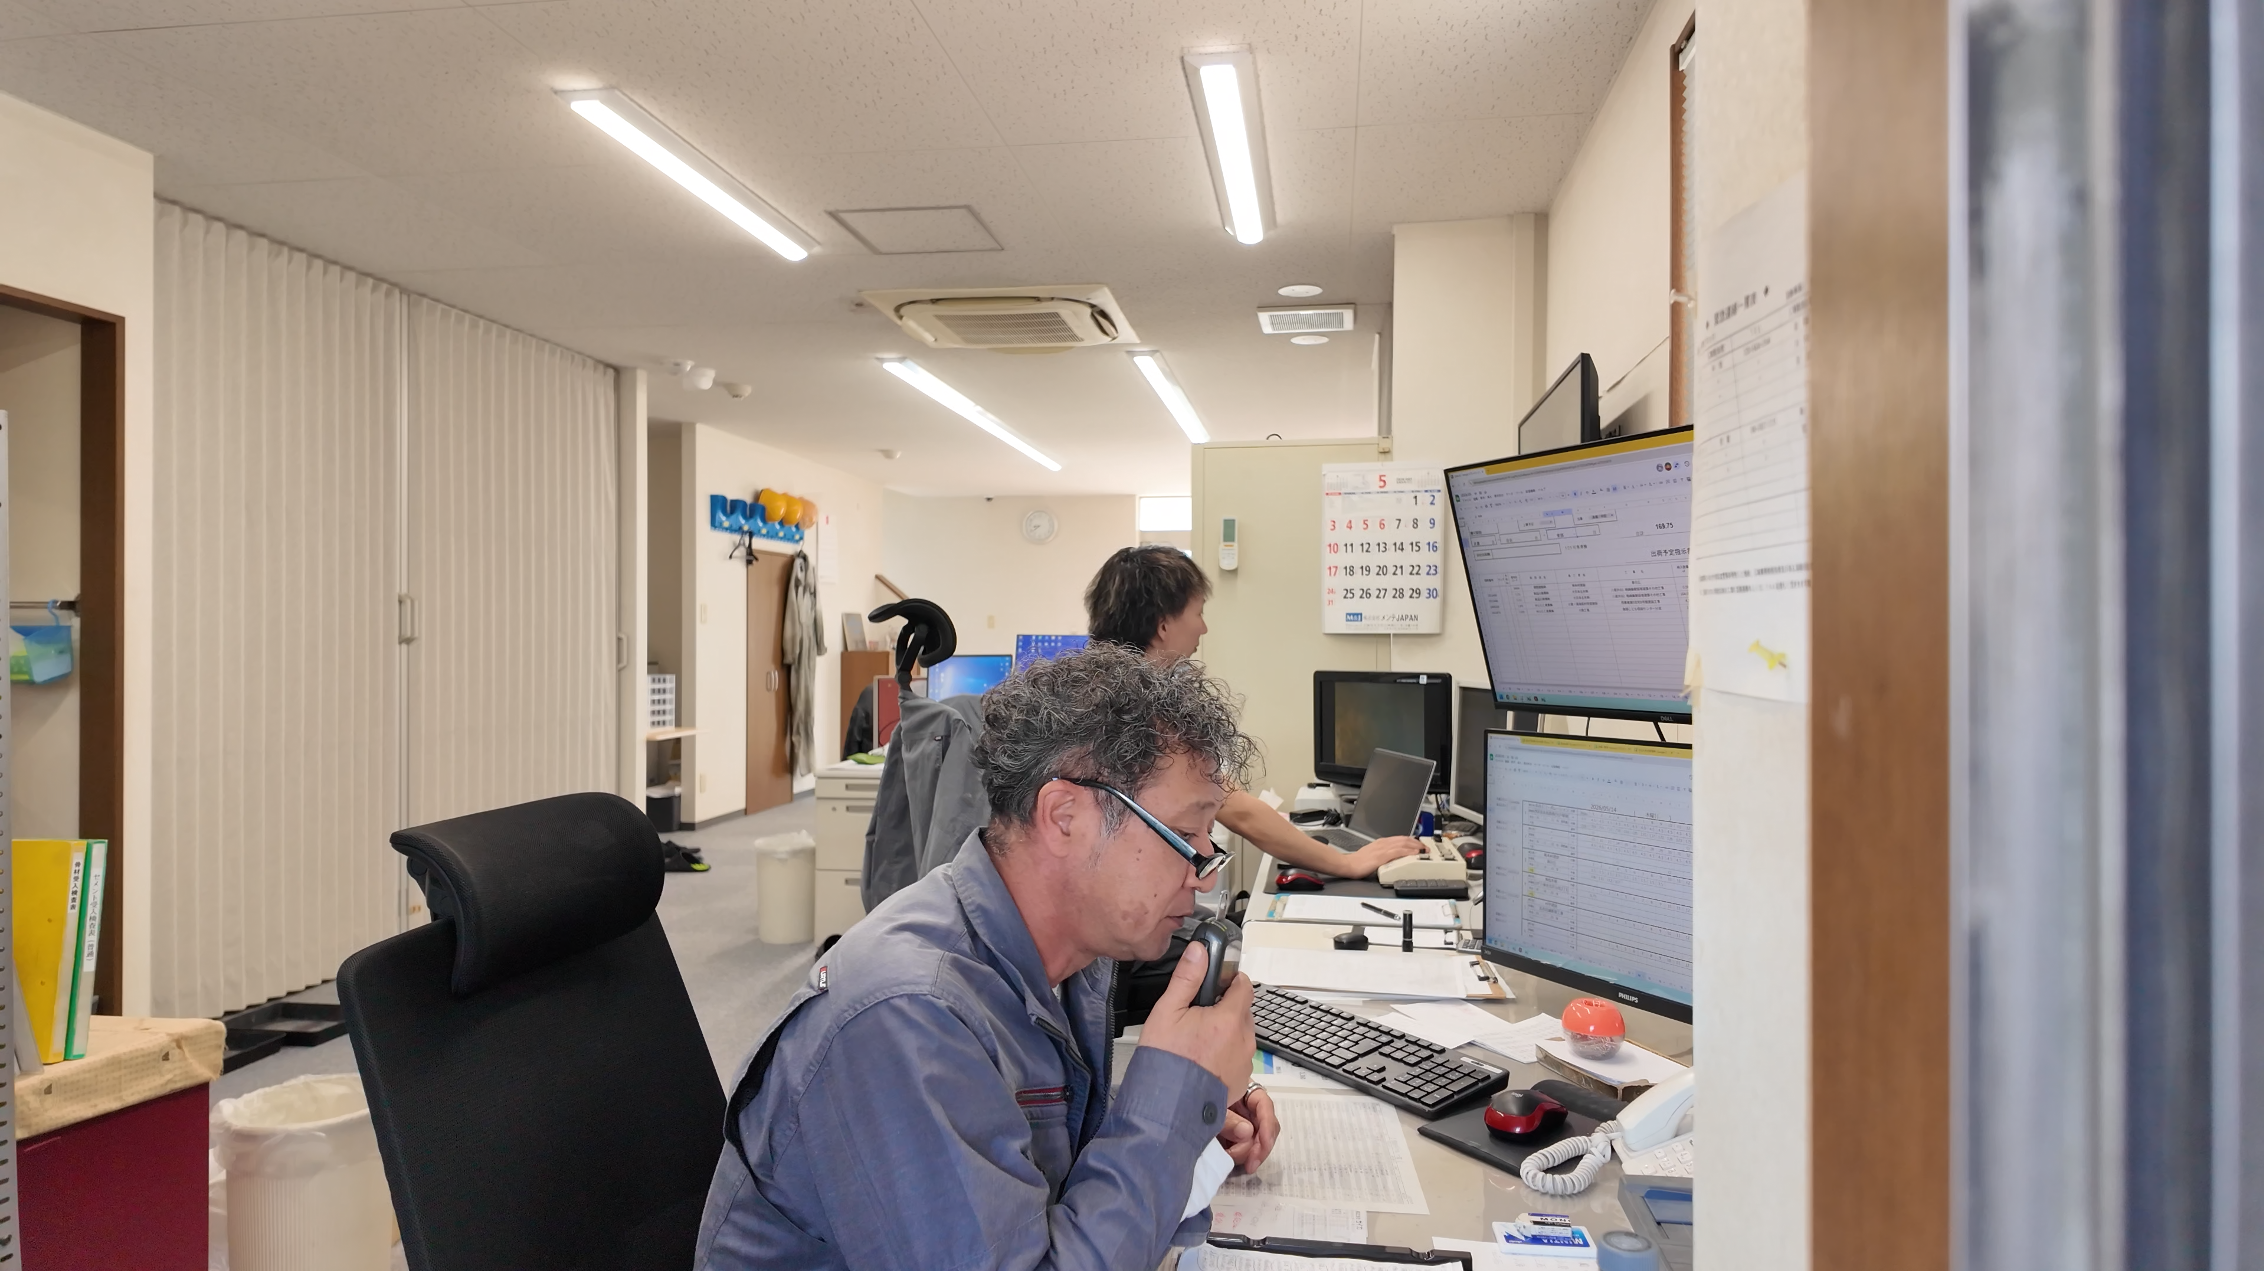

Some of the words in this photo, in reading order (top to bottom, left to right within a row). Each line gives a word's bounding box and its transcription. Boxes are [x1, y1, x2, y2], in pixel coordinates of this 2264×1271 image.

[1379, 475, 1386, 488] 5
[1413, 495, 1417, 505] 1
[1430, 495, 1435, 505] 2
[1330, 520, 1336, 531] 3
[1346, 520, 1352, 530] 4
[1363, 519, 1368, 530] 5
[1379, 519, 1385, 530] 6
[1396, 519, 1401, 529] 7
[1412, 518, 1418, 529] 8
[1429, 518, 1435, 529] 9
[1328, 543, 1338, 554] 10
[1344, 543, 1353, 553] 11
[1360, 542, 1370, 553] 12
[1376, 542, 1387, 553] 13
[1393, 542, 1404, 552] 14
[1410, 541, 1421, 552] 15
[1427, 541, 1438, 552] 16
[1328, 566, 1338, 576] 17
[1343, 565, 1354, 576] 18
[1360, 565, 1370, 576] 19
[1376, 565, 1387, 576] 20
[1392, 565, 1403, 575] 21
[1409, 565, 1421, 575] 22
[1426, 565, 1438, 575] 23
[1343, 588, 1354, 599] 25
[1359, 588, 1371, 599] 26
[1376, 588, 1387, 599] 27
[1392, 588, 1404, 599] 28
[1409, 588, 1421, 599] 29
[1426, 588, 1438, 599] 30
[1618, 992, 1639, 1003] PHILIPS
